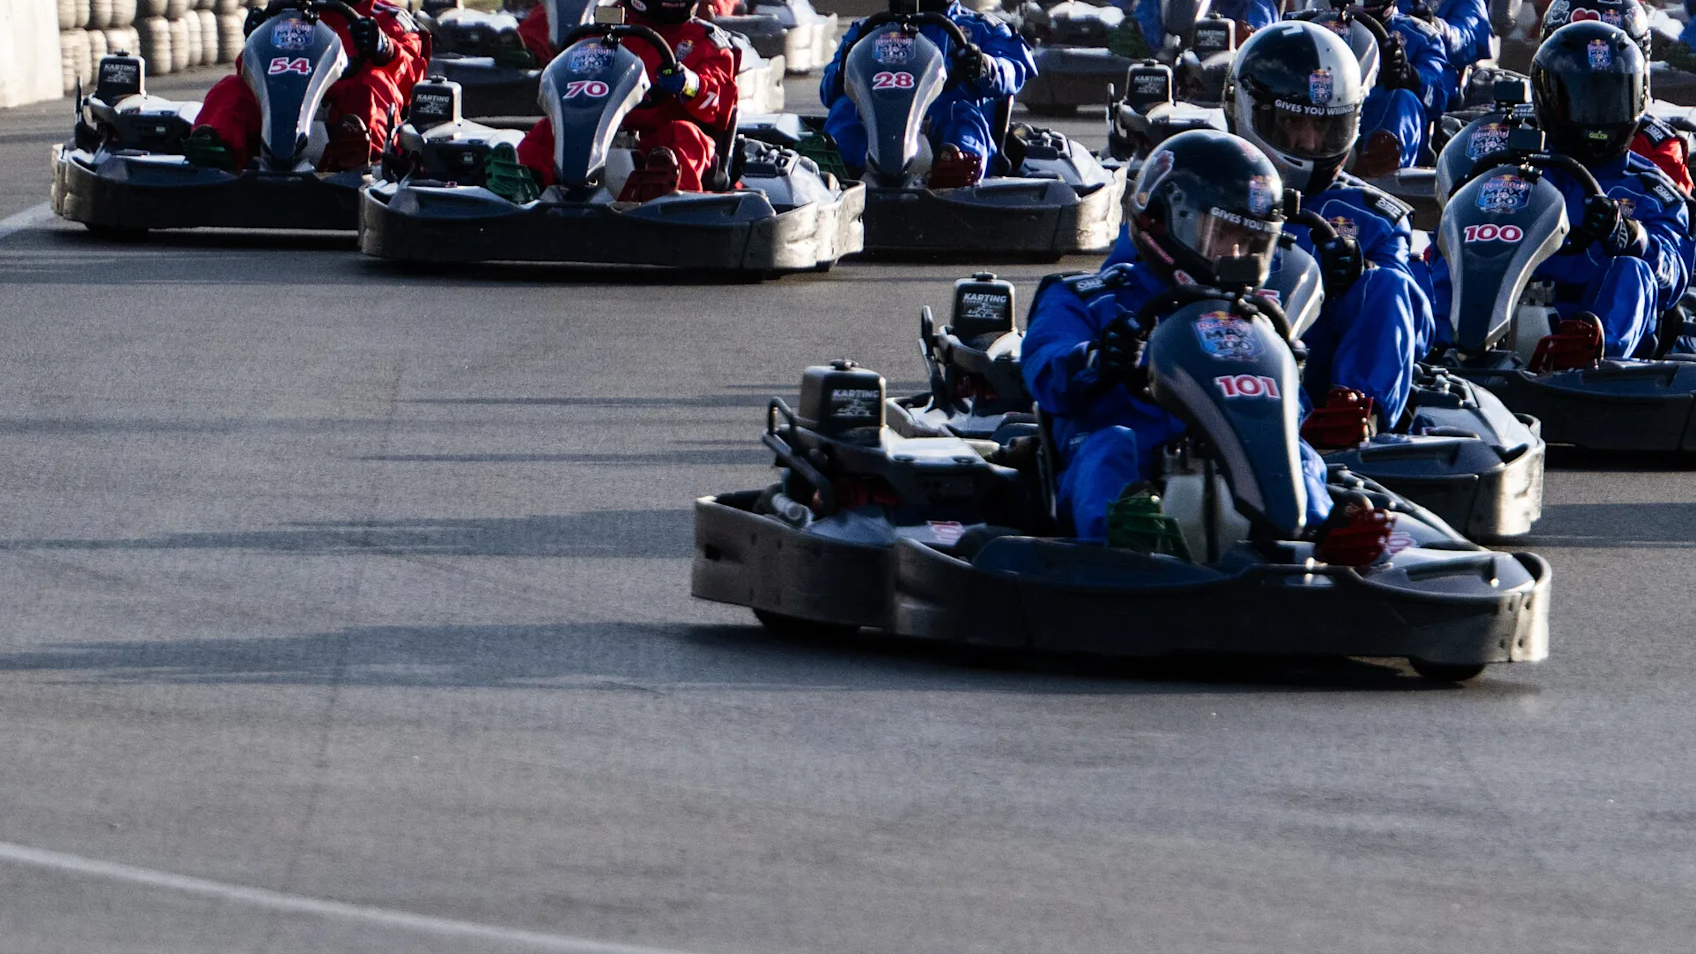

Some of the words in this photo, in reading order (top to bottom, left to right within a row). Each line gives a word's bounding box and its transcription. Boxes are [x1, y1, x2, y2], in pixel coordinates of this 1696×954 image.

[104, 63, 137, 72] KARTING
[268, 57, 311, 75] 54
[872, 71, 915, 90] 28
[563, 80, 609, 99] 70
[416, 93, 450, 103] KARTING
[1274, 98, 1302, 112] GIVES
[1304, 104, 1325, 115] YOU
[1326, 104, 1355, 116] WIIINGS
[1473, 136, 1509, 147] MAX
[1483, 189, 1524, 198] MAX
[1485, 197, 1517, 206] 100
[1210, 206, 1242, 225] GIVES
[1242, 217, 1263, 231] YOU
[1463, 223, 1524, 243] 100
[963, 293, 1007, 303] KARTING
[1205, 329, 1247, 339] MAX
[1214, 373, 1281, 399] 101
[832, 389, 880, 399] KARTING
